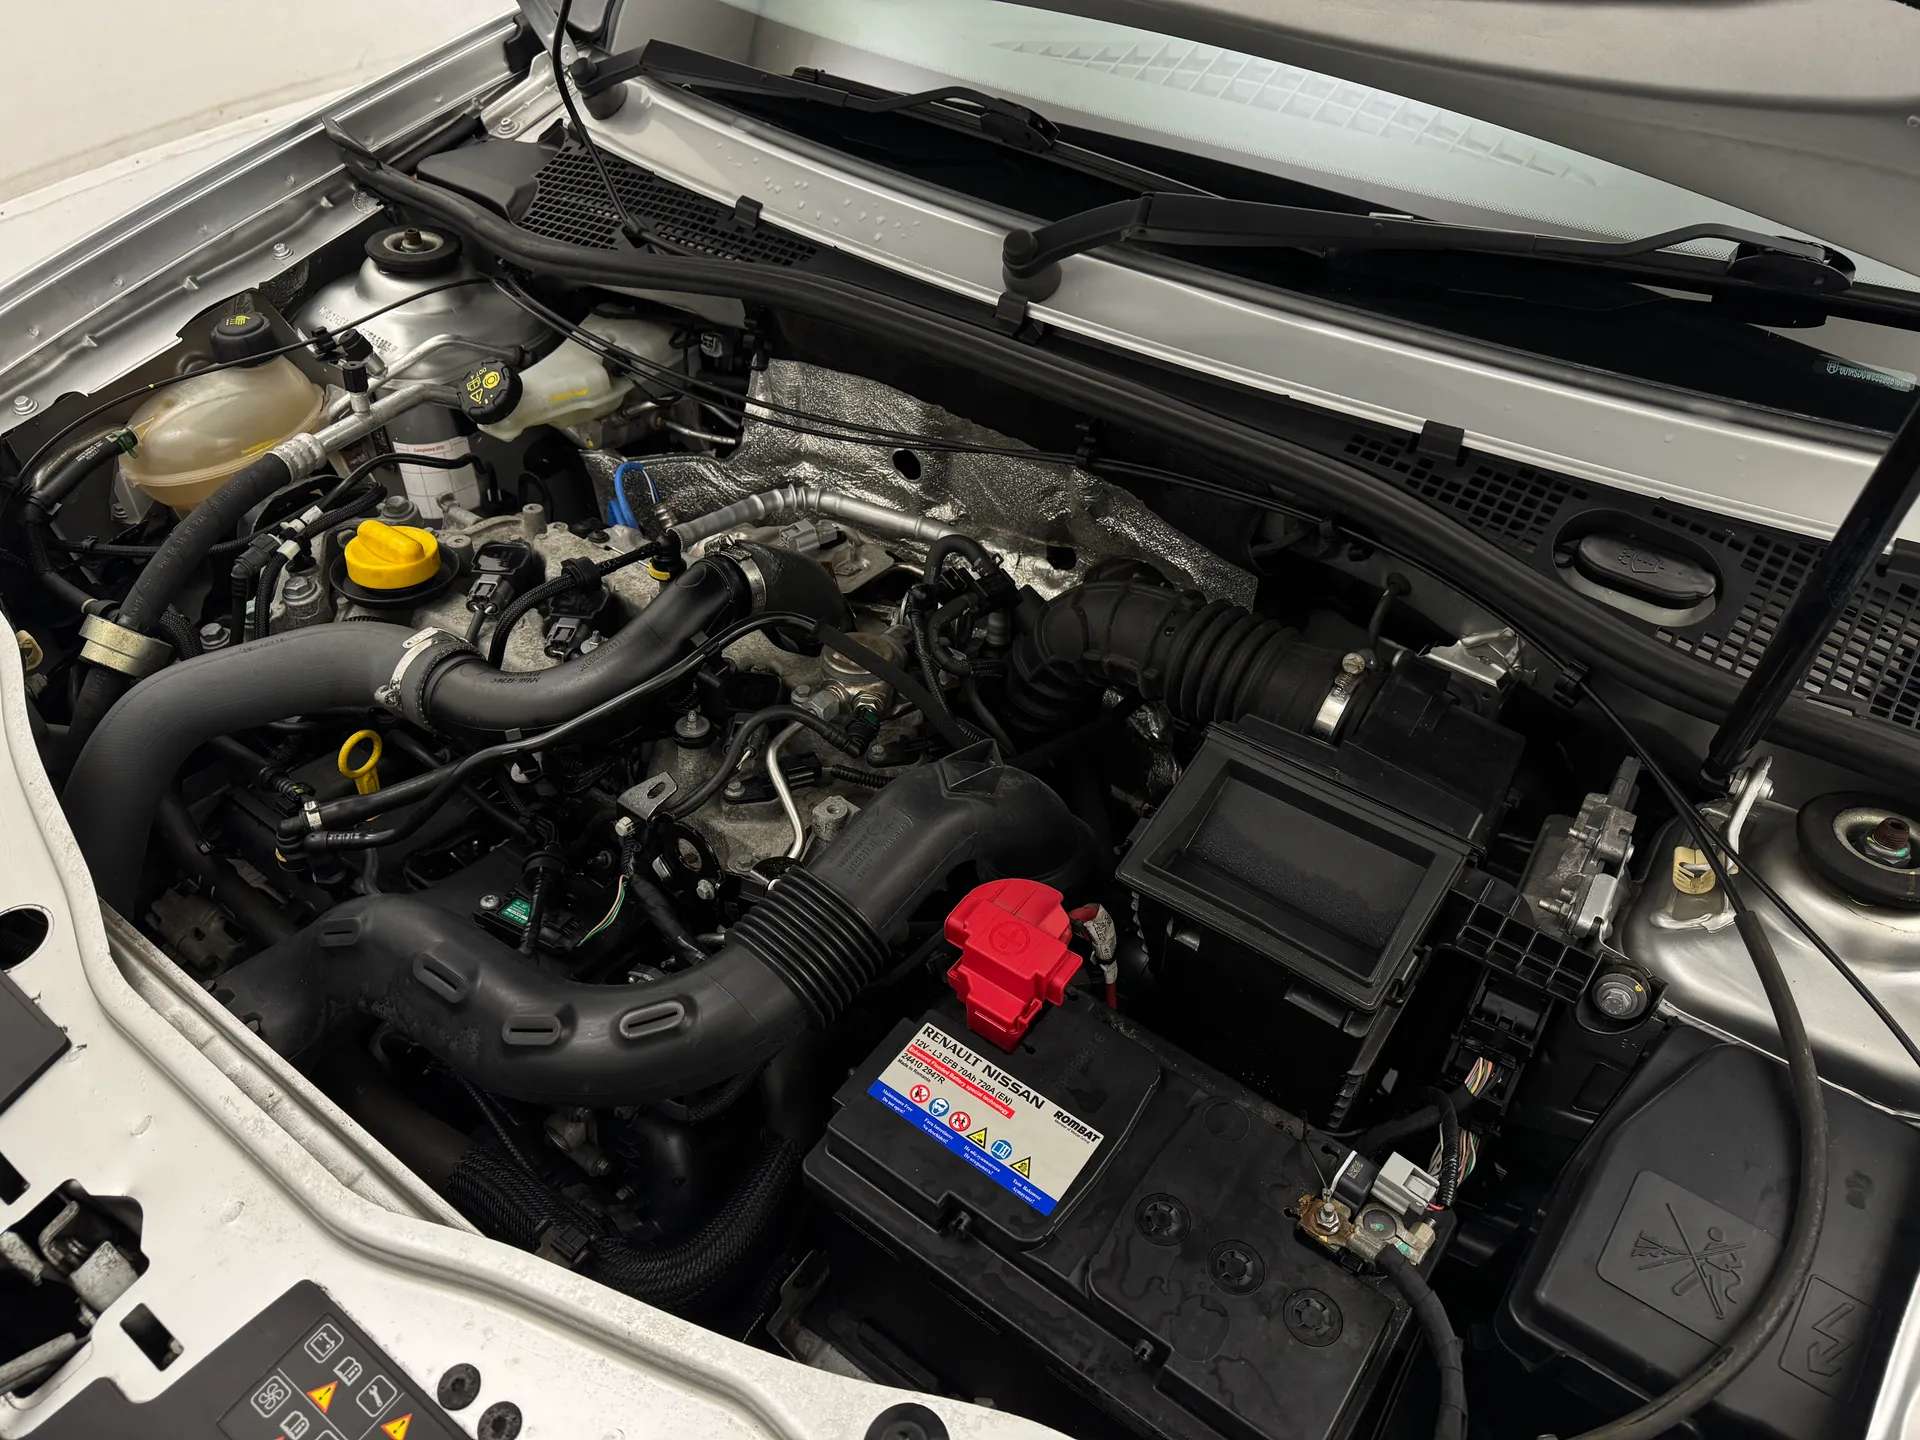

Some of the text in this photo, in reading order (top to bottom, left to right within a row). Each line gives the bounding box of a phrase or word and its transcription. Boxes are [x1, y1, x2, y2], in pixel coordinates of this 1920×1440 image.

[897, 1058, 908, 1067] Made
[901, 1051, 946, 1084] 24410 2947R
[909, 1046, 932, 1063] Enhanced
[948, 1072, 967, 1087] Battery
[965, 1083, 984, 1098] special
[915, 1038, 930, 1049] 12V
[932, 1049, 943, 1058] L3
[942, 1055, 959, 1069] EFB
[958, 1066, 978, 1081] 70Ah
[977, 1078, 997, 1094] 720A
[994, 1090, 1012, 1106] (EN)
[921, 1025, 1045, 1110] RENAULT NISSAN
[1053, 1109, 1100, 1144] ROMBAT
